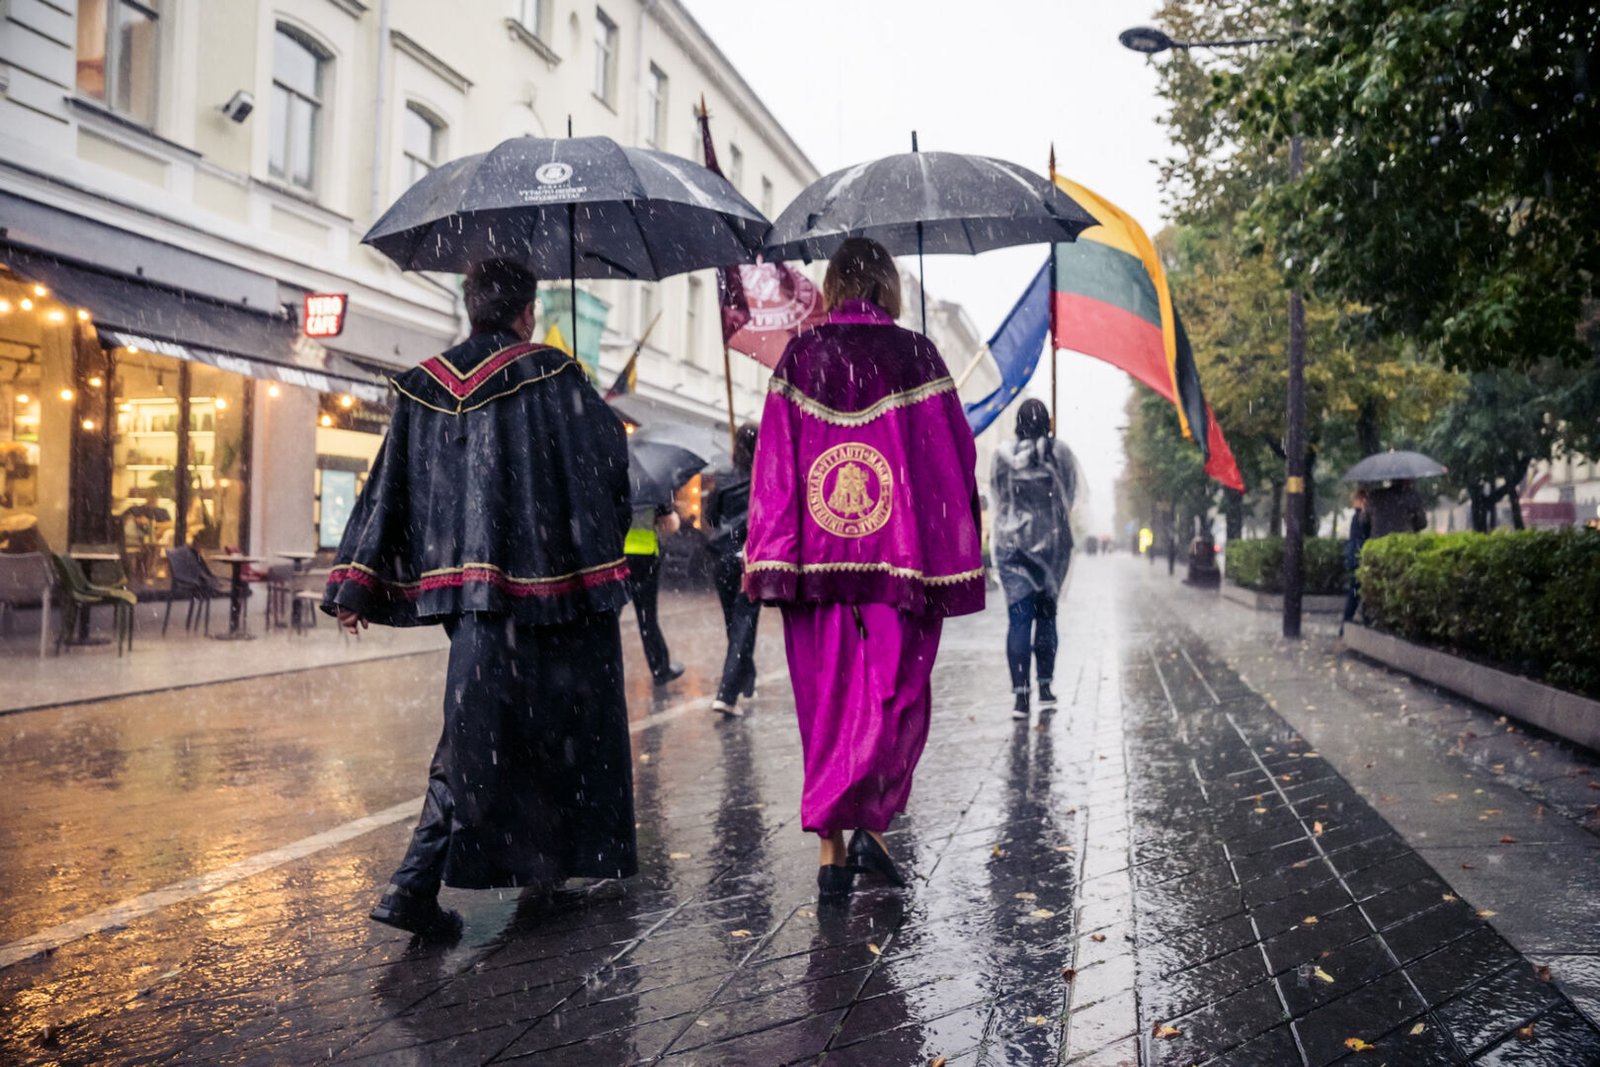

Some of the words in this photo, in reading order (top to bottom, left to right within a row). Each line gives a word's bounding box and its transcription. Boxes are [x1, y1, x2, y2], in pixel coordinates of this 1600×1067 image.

[307, 296, 342, 315] VERO
[306, 315, 338, 335] CAFE
[822, 446, 864, 468] VYTAUTI
[809, 469, 845, 531] UNIVERSITAS
